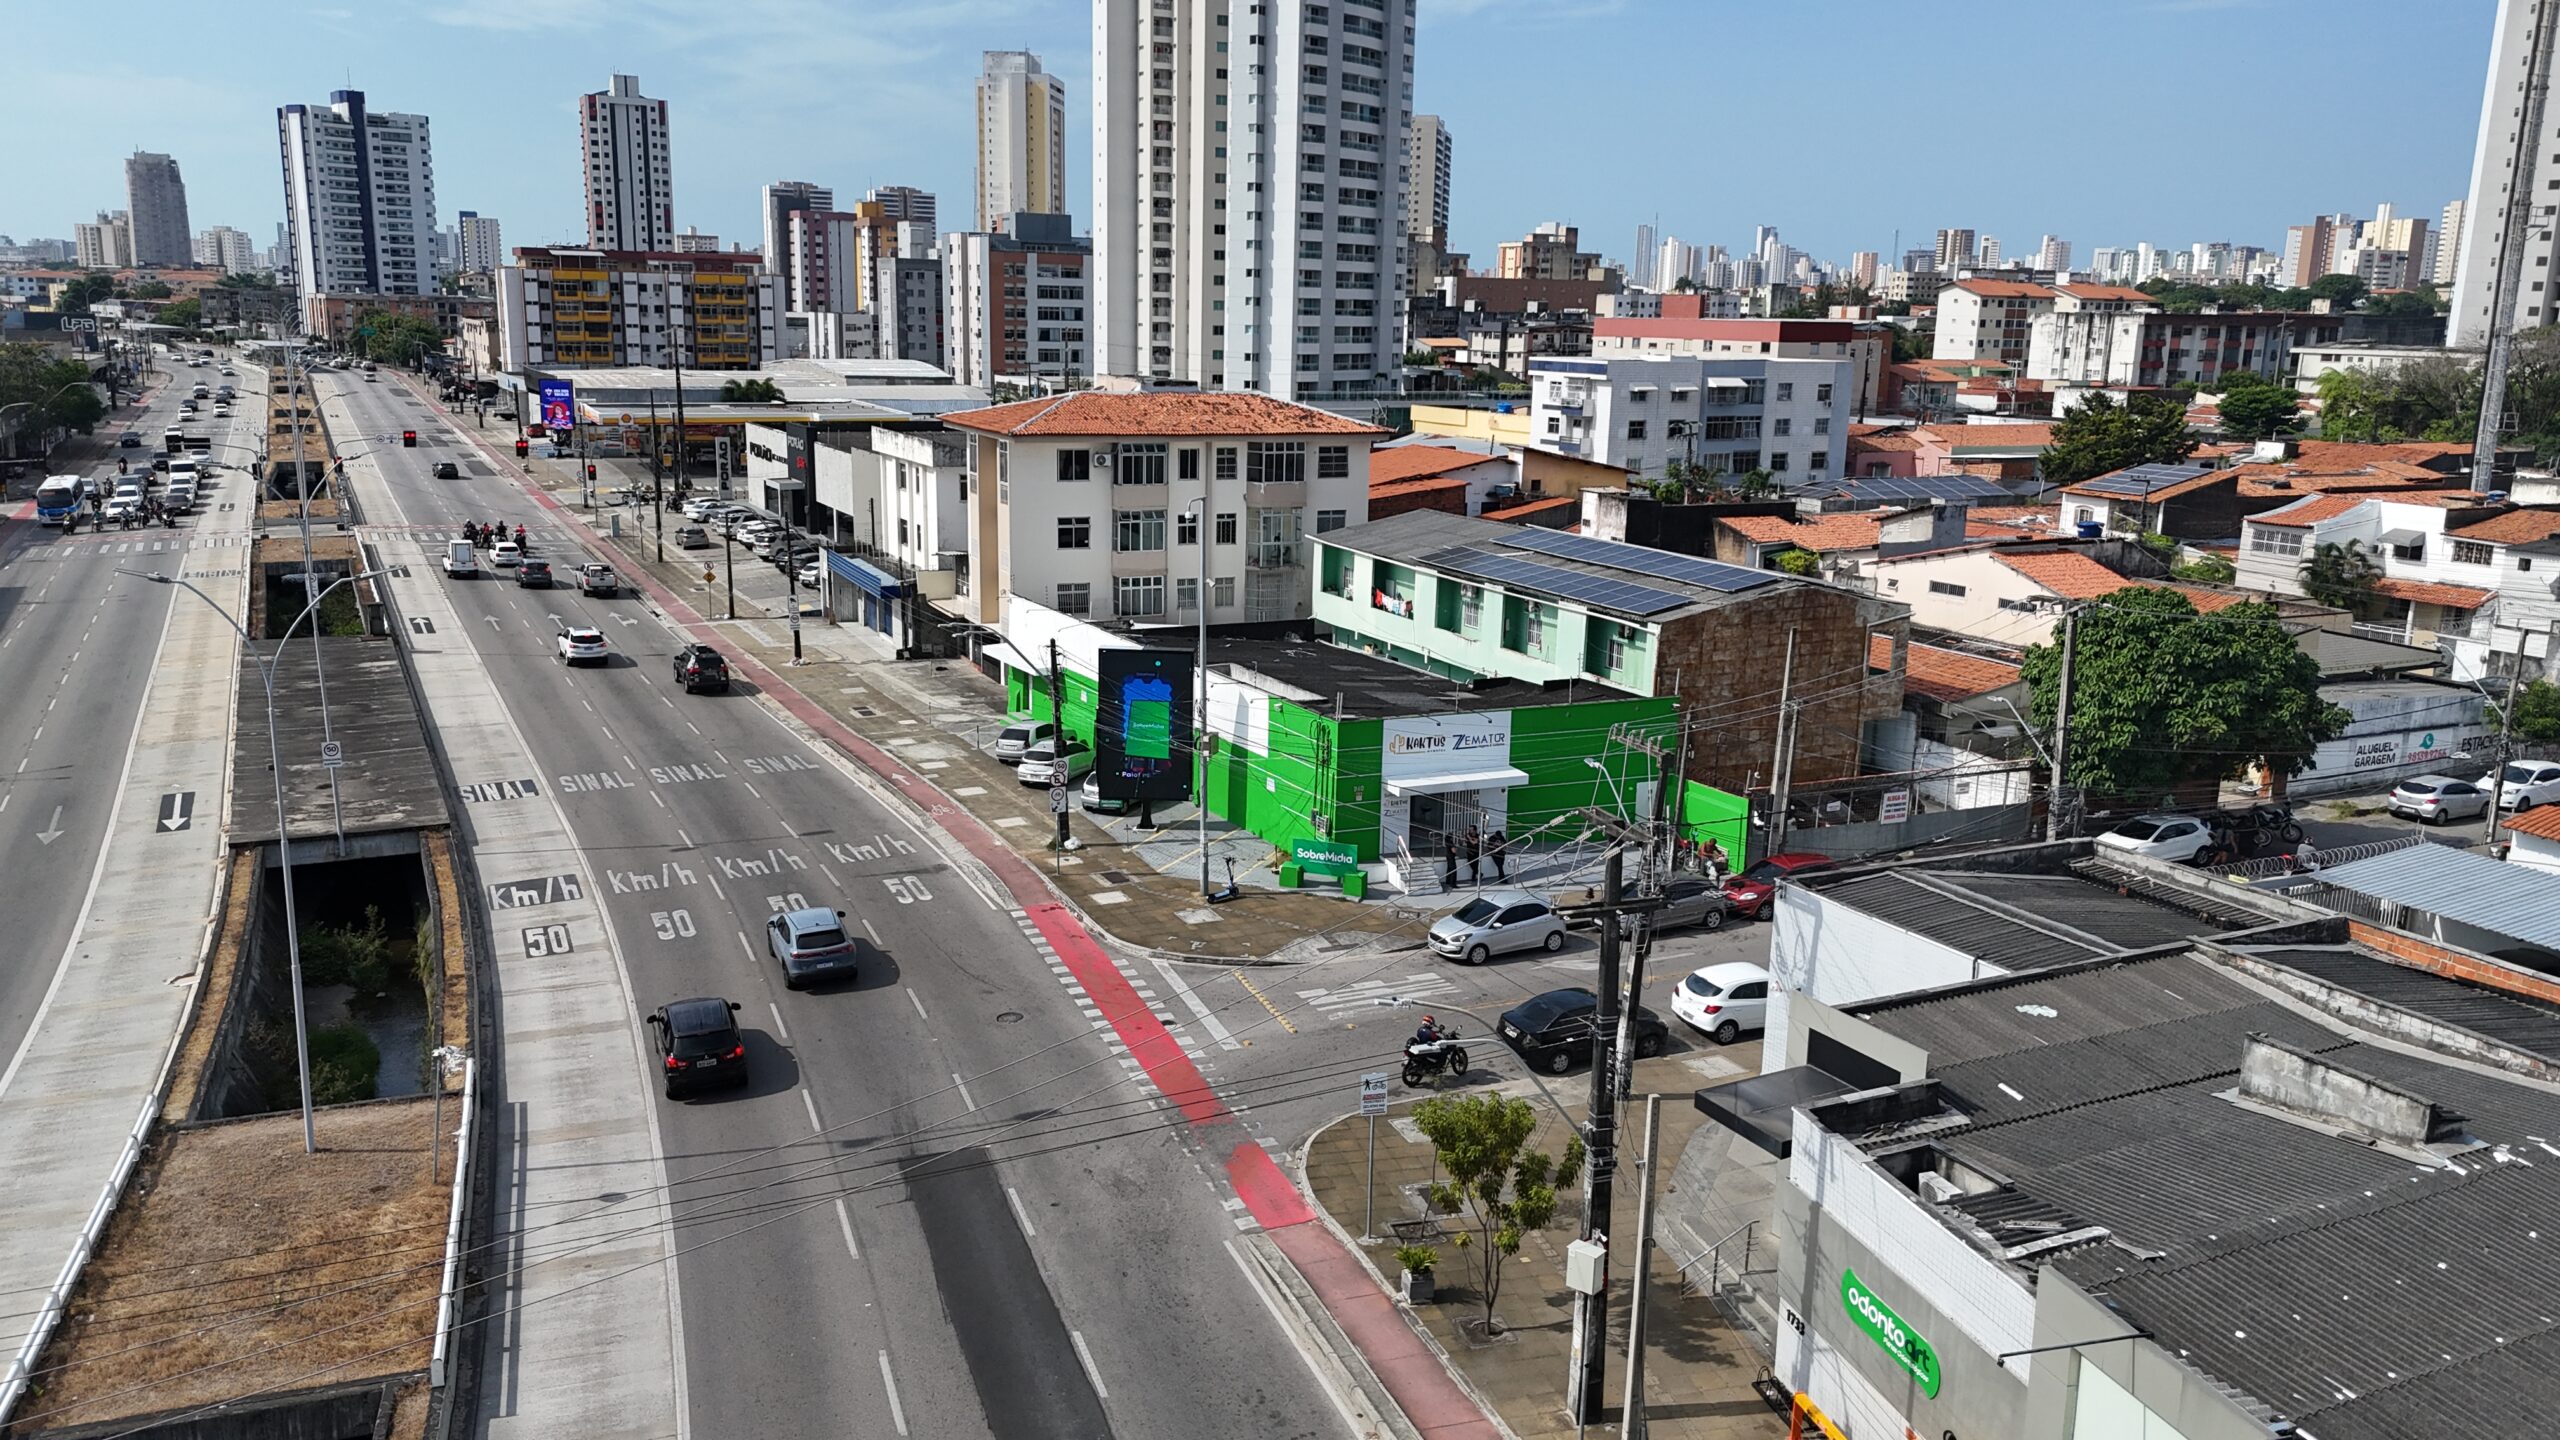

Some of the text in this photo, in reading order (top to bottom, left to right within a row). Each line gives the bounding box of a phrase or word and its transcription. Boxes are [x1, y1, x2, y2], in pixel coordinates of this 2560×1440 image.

[719, 441, 730, 490] PORÃO
[1406, 736, 1446, 750] KAKTUS
[2356, 742, 2394, 755] ALUGUEL
[649, 763, 727, 785] SINAL
[742, 754, 820, 775] SINAL
[2354, 753, 2396, 768] GARAGEM
[459, 780, 535, 802] SINAL
[559, 771, 635, 793] SINAL
[824, 834, 917, 863] Km/h
[606, 862, 698, 894] Km/h
[715, 849, 808, 879] Km/h
[490, 876, 582, 910] Km/h
[882, 876, 933, 904] 50
[651, 909, 697, 940] 50
[525, 925, 569, 957] 50
[1786, 1309, 1805, 1336] 1733
[1848, 1287, 1930, 1373] odontoart
